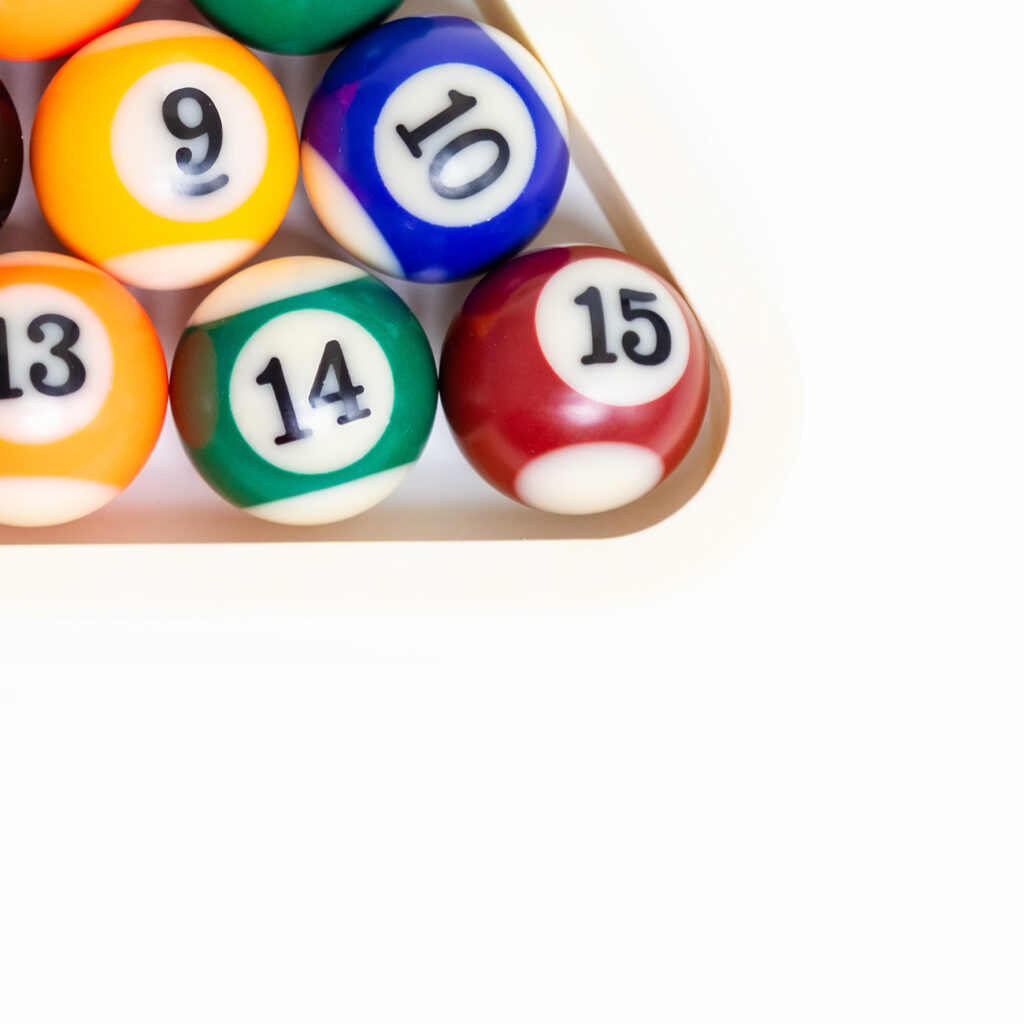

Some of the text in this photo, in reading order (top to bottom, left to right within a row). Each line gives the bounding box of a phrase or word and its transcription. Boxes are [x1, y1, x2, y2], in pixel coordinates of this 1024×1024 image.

[162, 87, 224, 177] 9
[396, 90, 511, 200] 10
[575, 286, 672, 367] 15
[256, 340, 371, 445] 14
